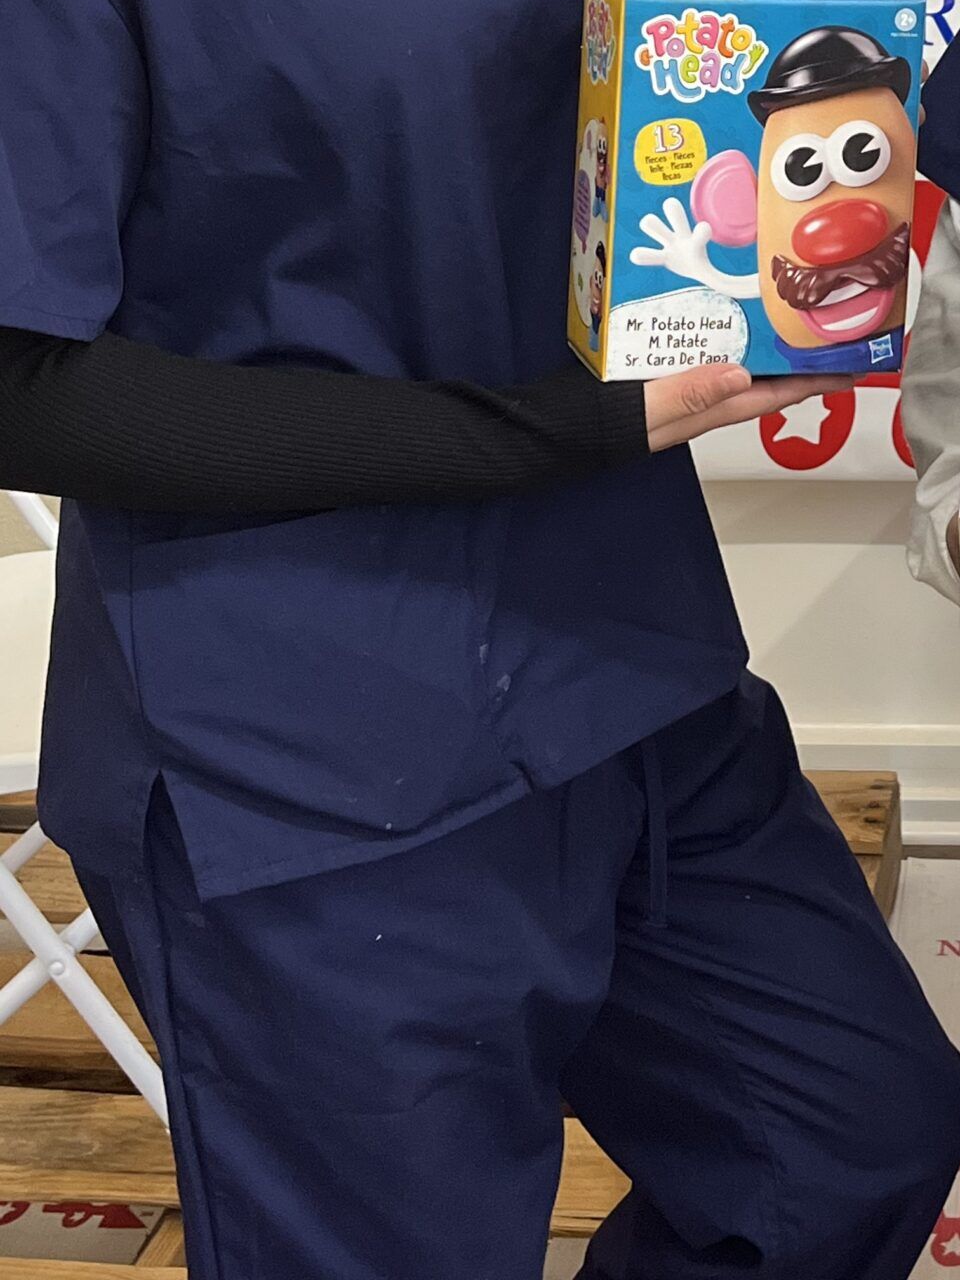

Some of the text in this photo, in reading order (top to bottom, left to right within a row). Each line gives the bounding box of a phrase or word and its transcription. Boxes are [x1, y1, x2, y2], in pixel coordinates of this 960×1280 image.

[646, 11, 753, 59] Potato
[652, 50, 748, 98] Head
[654, 124, 685, 153] 13
[651, 316, 696, 331] Potato
[700, 315, 732, 331] Head
[667, 333, 708, 349] Patate
[647, 353, 675, 366] Cara
[680, 352, 695, 365] De
[700, 350, 729, 364] Papa
